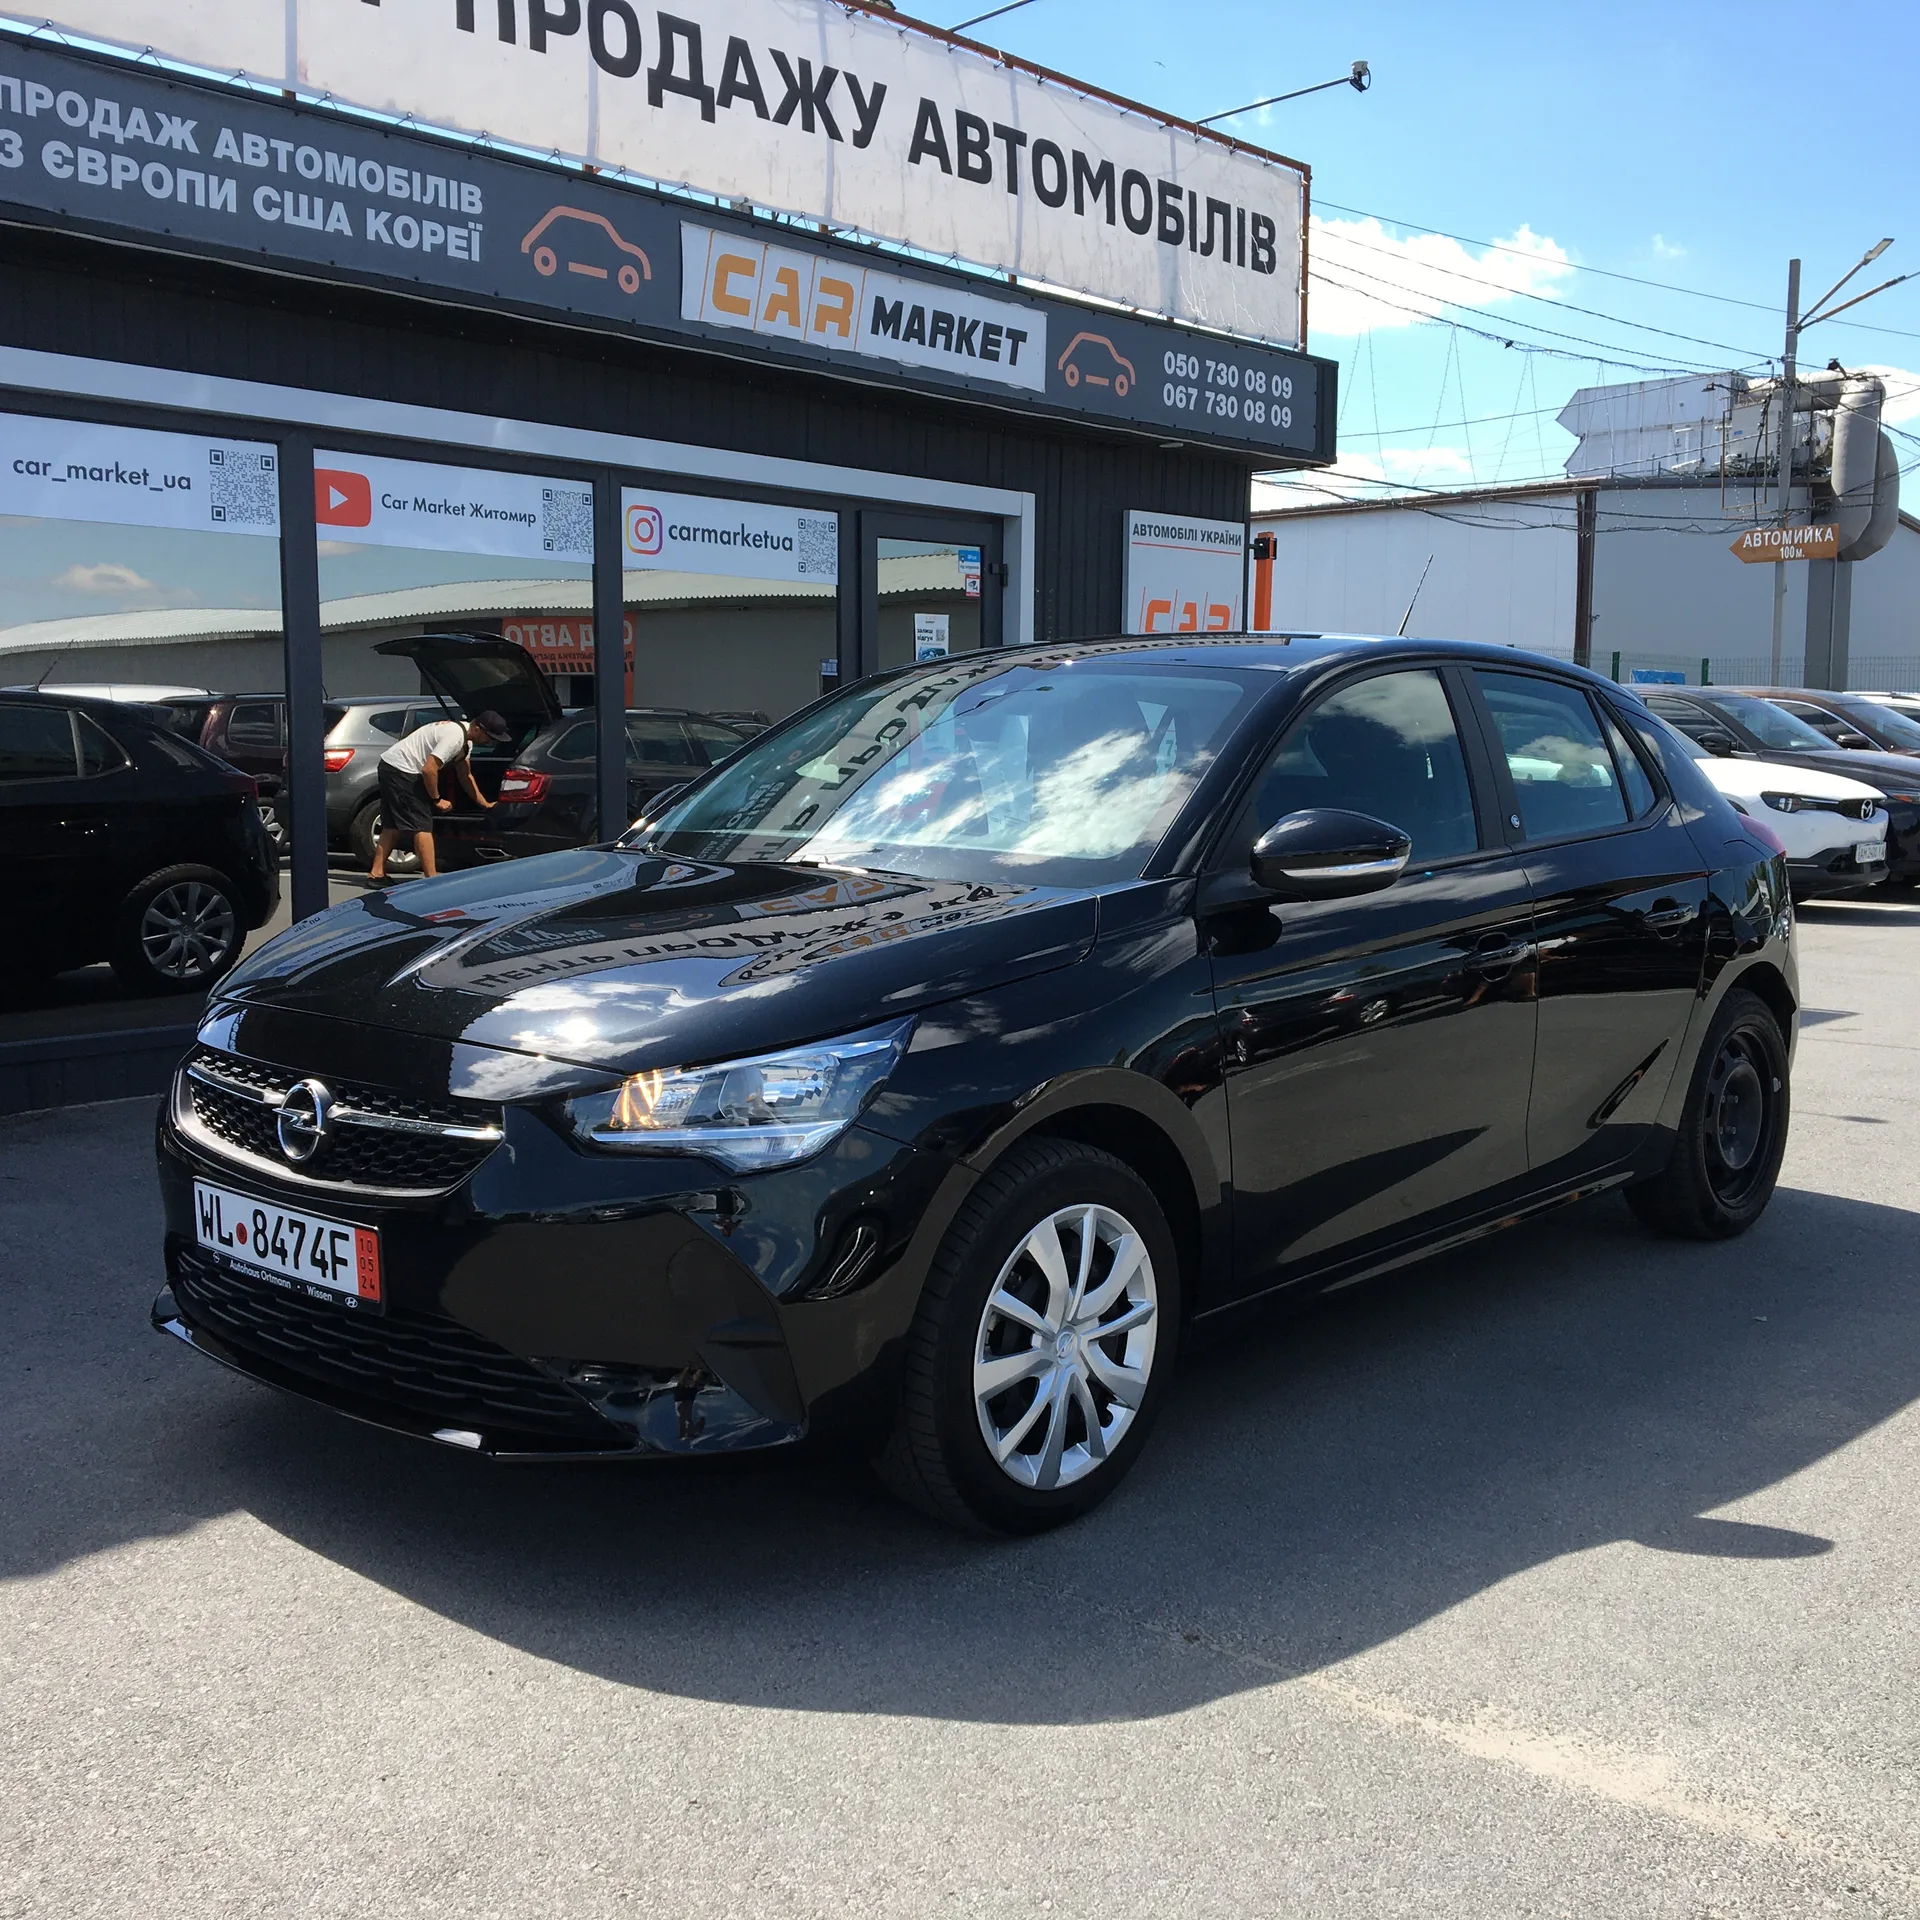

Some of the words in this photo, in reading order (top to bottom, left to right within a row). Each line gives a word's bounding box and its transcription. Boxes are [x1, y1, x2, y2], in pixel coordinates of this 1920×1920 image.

[0, 75, 200, 154] ПРОДАЖ
[213, 127, 483, 214] АВТОМОБІЛІВ
[41, 140, 237, 213] ЄВРОПИ
[253, 185, 353, 236] США
[366, 207, 483, 262] КОРЕЇ
[907, 97, 1276, 275] АВТОМОБІЛІВ
[712, 253, 854, 338] CAR
[871, 295, 1028, 366] MARKET
[1163, 351, 1199, 379] 050
[1205, 359, 1239, 388] 730
[1244, 369, 1266, 394] 08
[1271, 375, 1292, 399] 09
[1163, 382, 1198, 411] 067
[1205, 391, 1238, 418] 730
[1244, 399, 1265, 423] 08
[1271, 404, 1292, 428] 09
[13, 458, 191, 492] car_market_ua
[381, 493, 408, 510] Car
[413, 496, 465, 516] Market
[469, 502, 537, 527] Житомир
[668, 523, 793, 551] carmarketua
[1132, 523, 1197, 541] АВТОМОБІЛІ
[1200, 530, 1241, 546] УКРАЇНИ
[1743, 526, 1834, 548] АВТОМИЙКА
[198, 1189, 234, 1248] WL
[252, 1208, 350, 1282] 8474F
[359, 1237, 373, 1254] 10
[229, 1259, 260, 1280] Autohaus
[260, 1269, 292, 1289] Ortmann
[306, 1284, 333, 1302] Wissen
[359, 1258, 374, 1273] 05
[361, 1275, 376, 1292] 24
